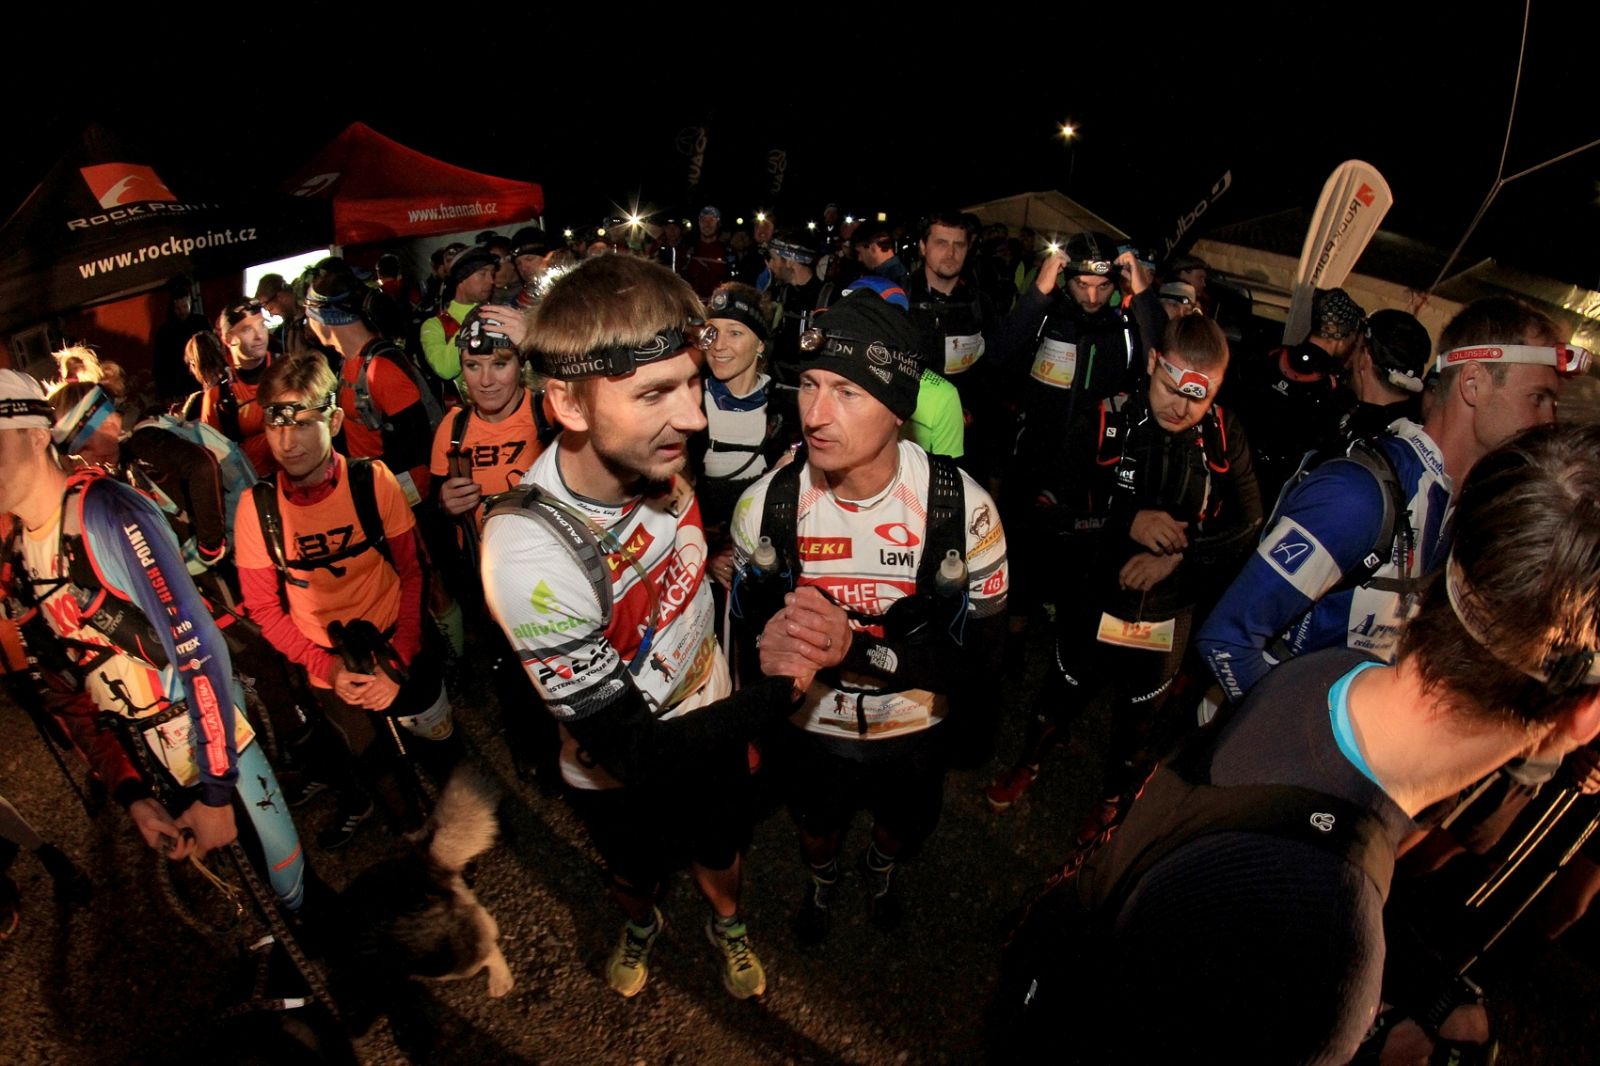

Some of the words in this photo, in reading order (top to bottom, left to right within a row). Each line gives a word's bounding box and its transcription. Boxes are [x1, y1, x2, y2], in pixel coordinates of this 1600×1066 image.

[66, 203, 145, 231] ROCK
[407, 200, 498, 223] www.hannah.cz
[1333, 198, 1362, 242] ROCK
[78, 227, 257, 280] www.rockpoint.cz
[123, 522, 156, 568] POINT
[799, 542, 845, 555] LEKI
[880, 549, 915, 568] lawi
[146, 564, 174, 604] HIGH
[827, 583, 875, 605] THE
